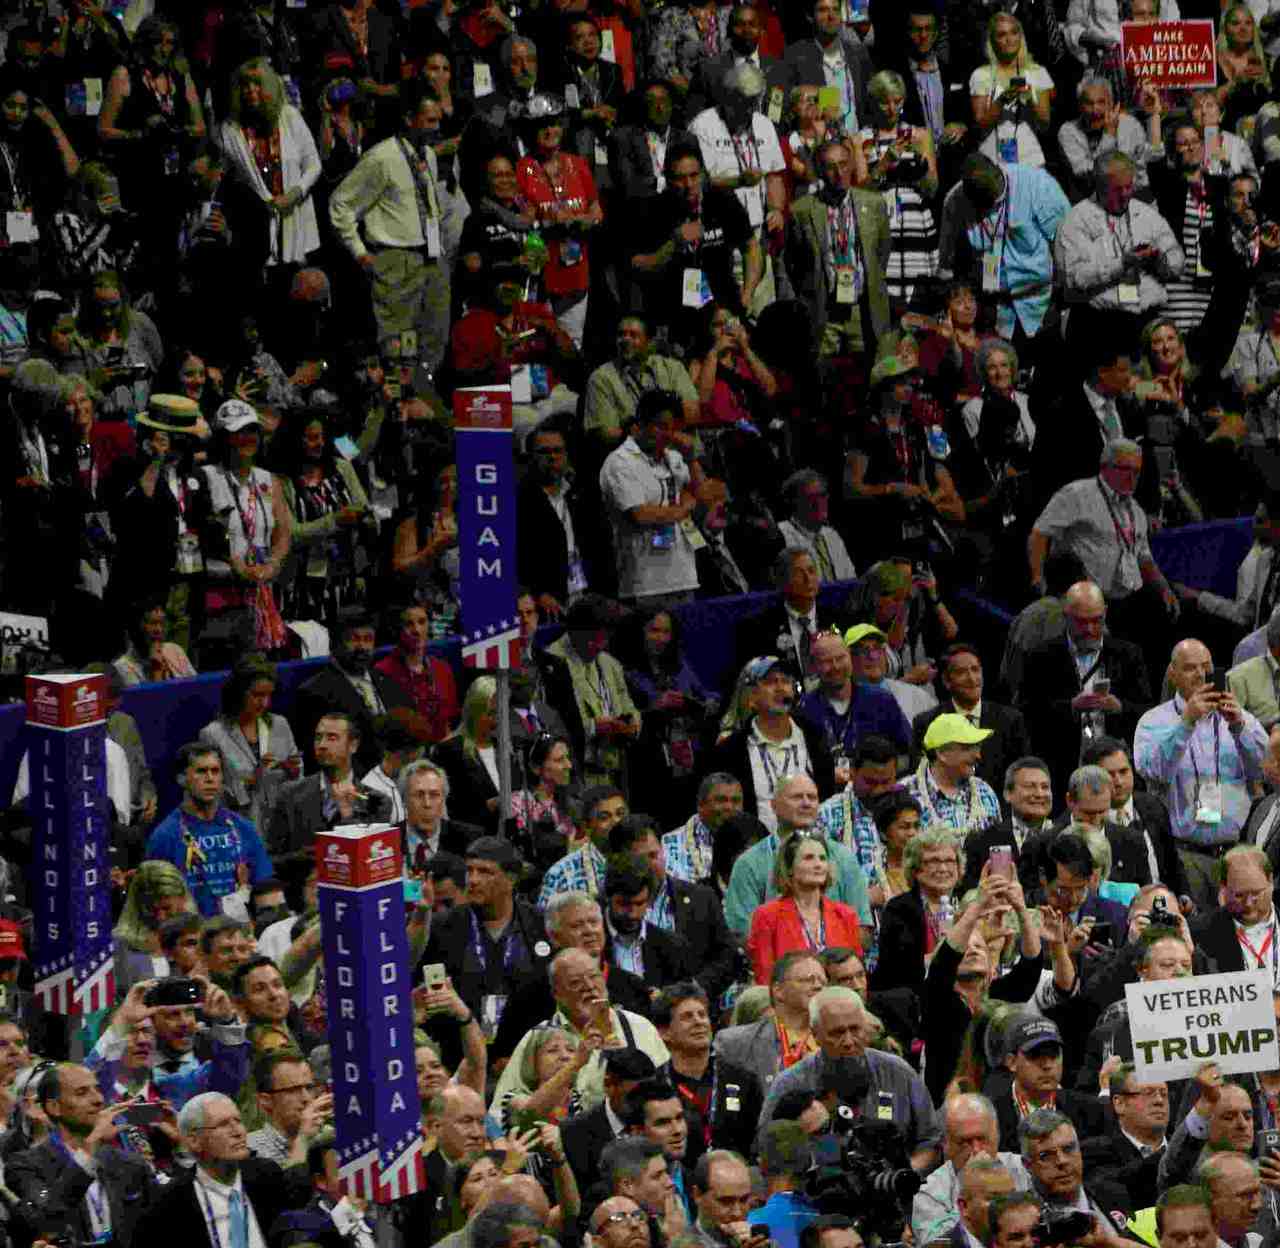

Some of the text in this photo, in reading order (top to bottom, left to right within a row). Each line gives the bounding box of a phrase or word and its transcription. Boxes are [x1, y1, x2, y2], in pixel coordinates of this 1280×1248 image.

[1125, 43, 1212, 62] AMERICA
[1153, 30, 1184, 42] MAKE
[1133, 62, 1206, 76] SAFE AGAIN
[474, 462, 503, 579] GUAM
[42, 737, 62, 942] ILLINOIS
[81, 737, 101, 940] ILLINOIS
[334, 901, 362, 1118] FLORIDA
[376, 897, 407, 1114] FLORIDA
[1144, 983, 1258, 1012] VETERANS
[1185, 1012, 1223, 1030] FOR
[1135, 1028, 1275, 1064] TRUMP
